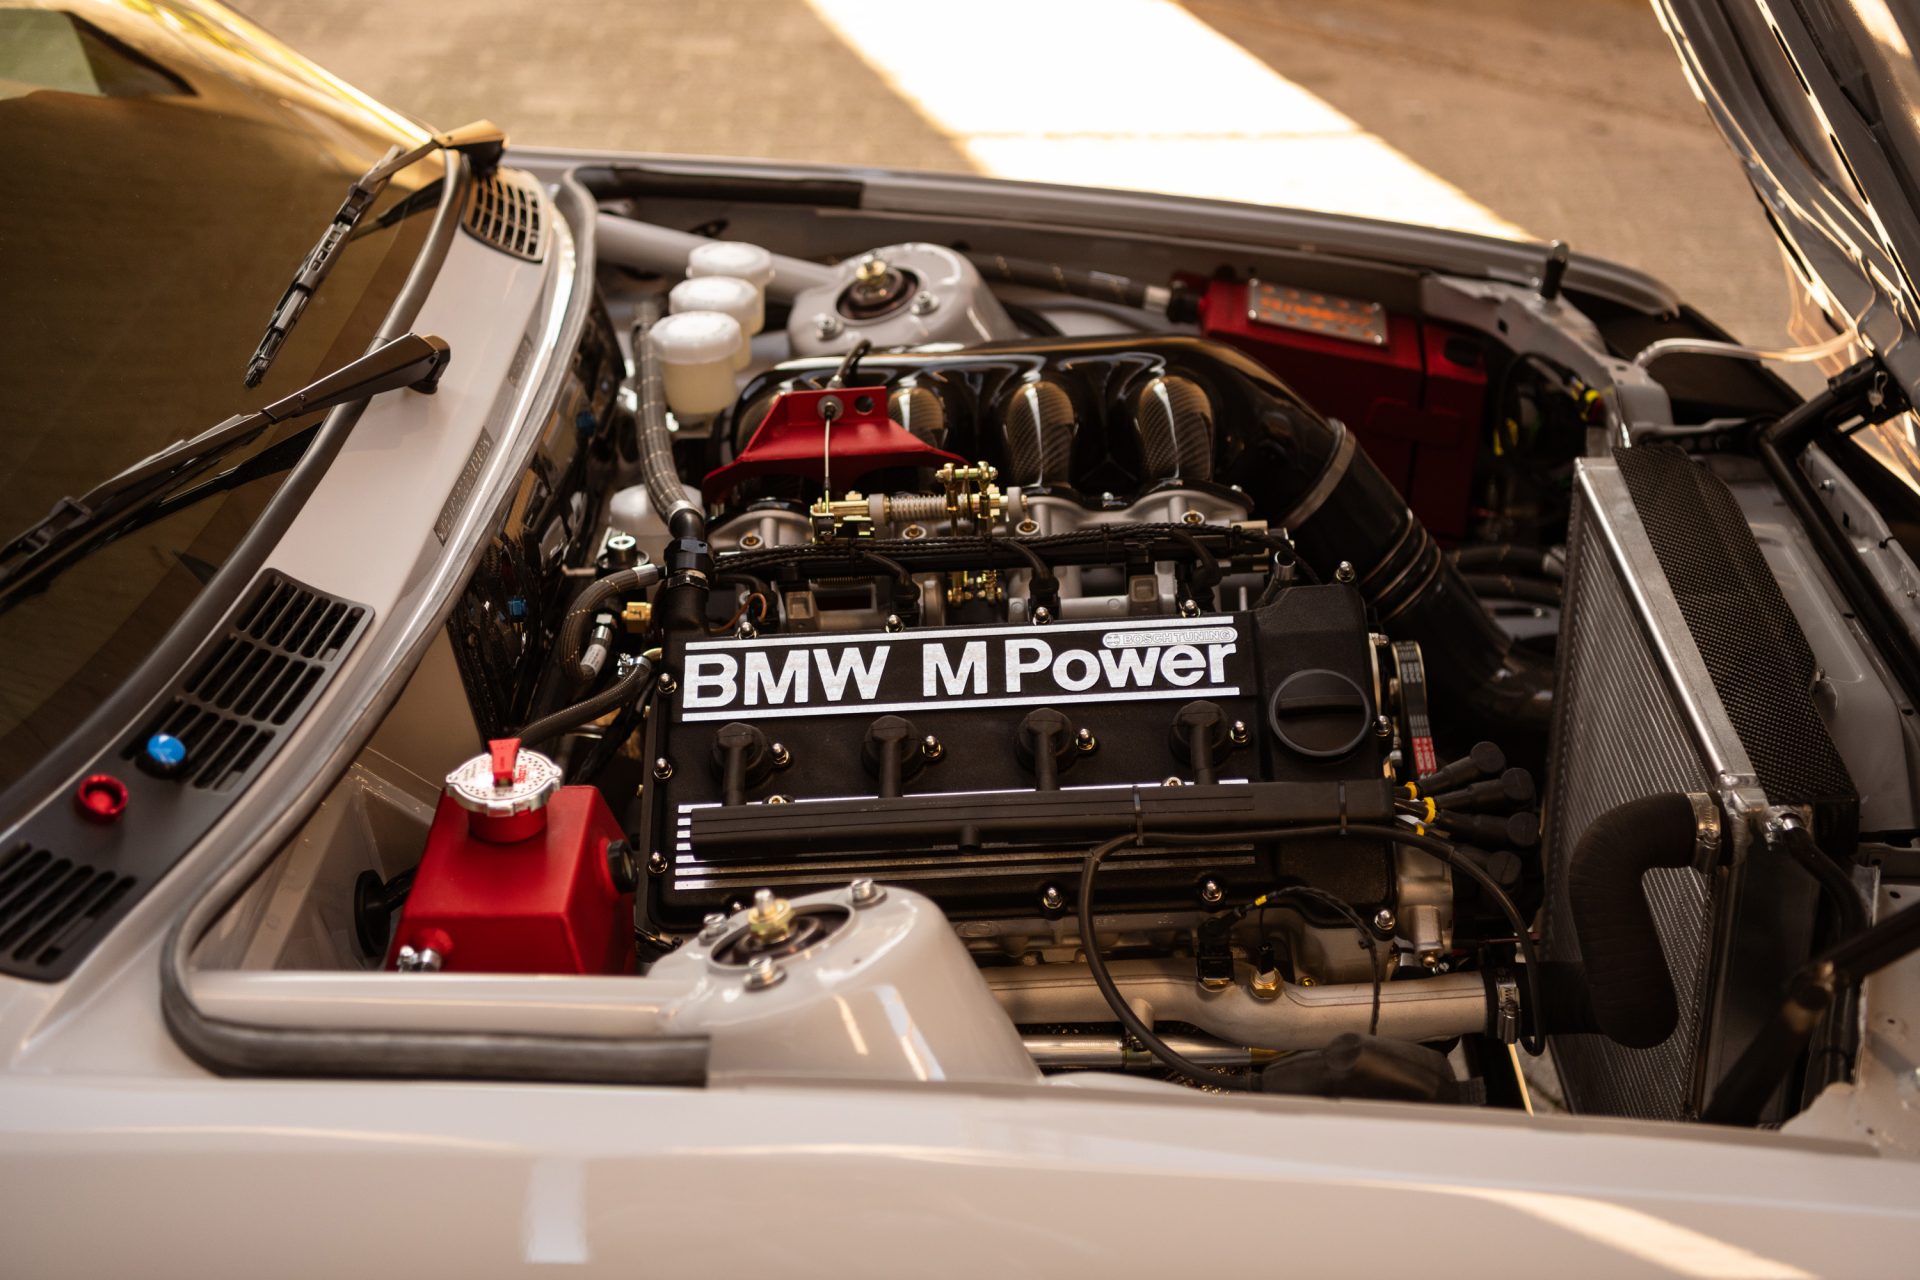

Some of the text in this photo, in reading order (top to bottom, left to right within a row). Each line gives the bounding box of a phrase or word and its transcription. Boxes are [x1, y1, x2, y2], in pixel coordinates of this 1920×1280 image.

[682, 639, 1237, 708] BMW M Power
